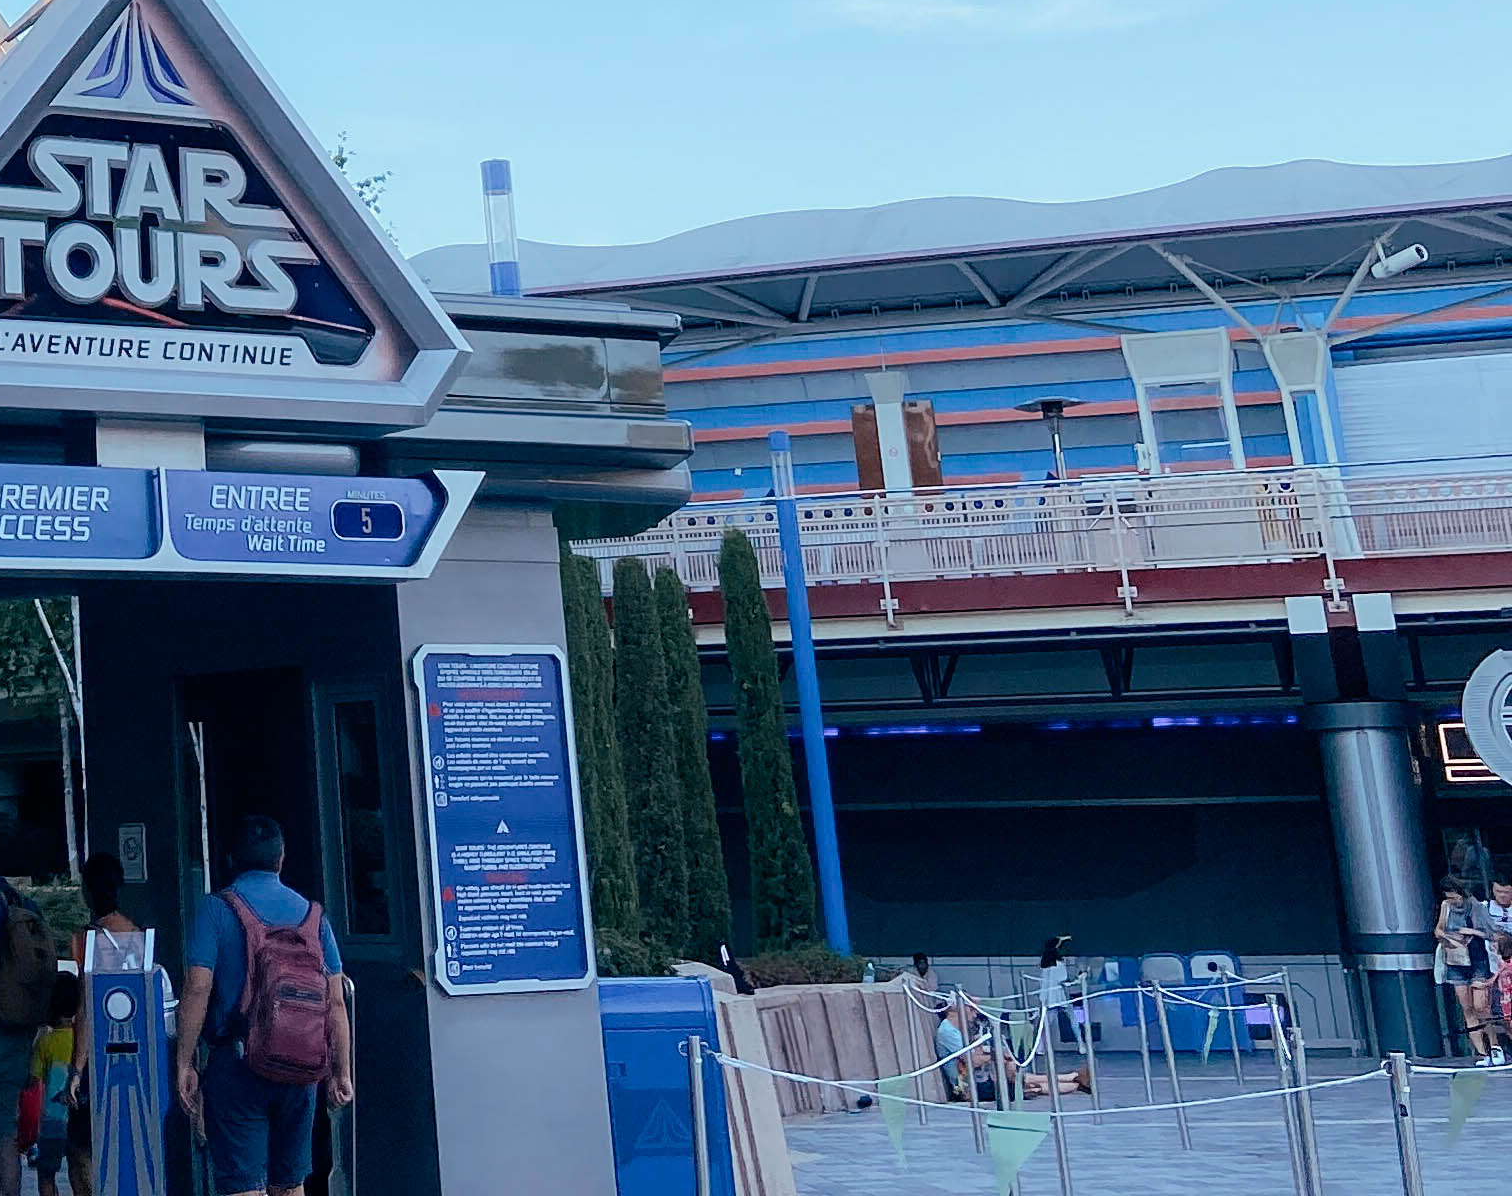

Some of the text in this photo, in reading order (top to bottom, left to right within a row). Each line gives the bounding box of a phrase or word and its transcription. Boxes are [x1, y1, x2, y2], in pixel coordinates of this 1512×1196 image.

[161, 339, 294, 367] CONTINUE
[211, 484, 312, 512] ENTREE
[184, 513, 313, 535] Temps d'attente
[361, 507, 373, 534] 5
[247, 534, 326, 553] Wait Time
